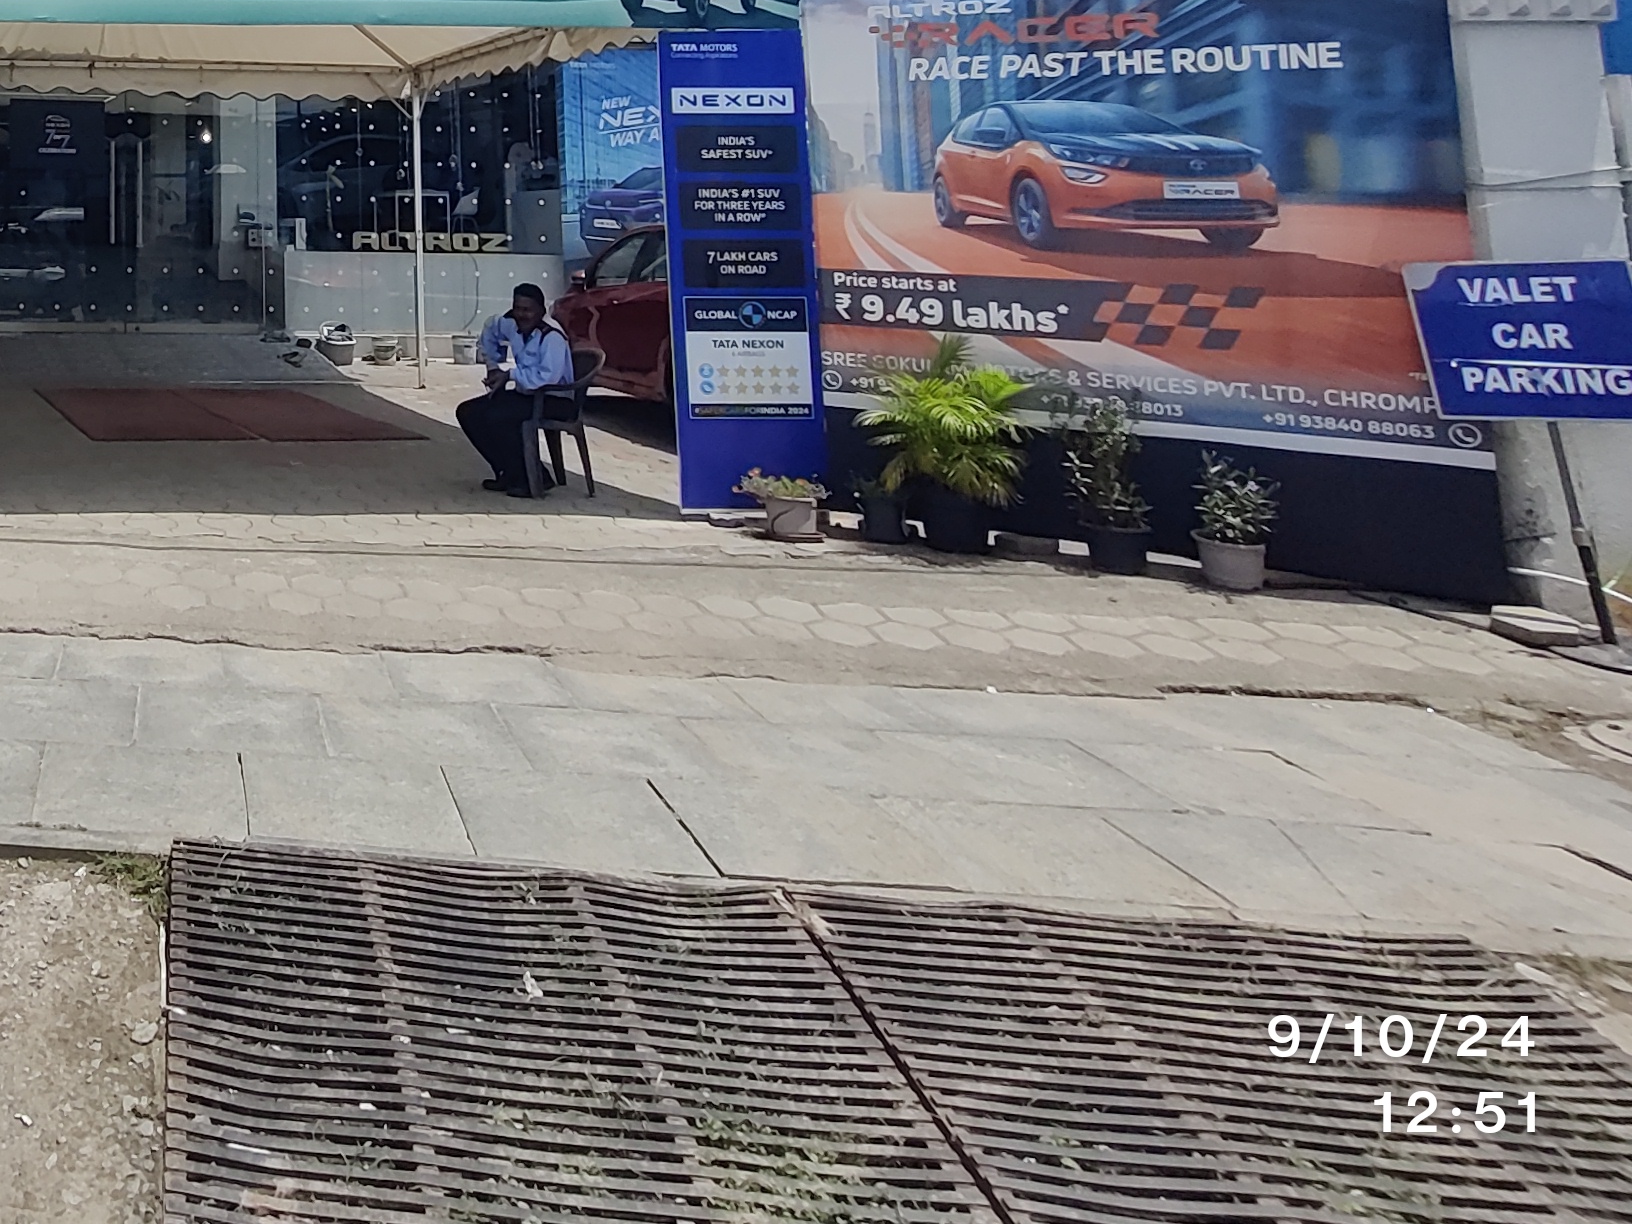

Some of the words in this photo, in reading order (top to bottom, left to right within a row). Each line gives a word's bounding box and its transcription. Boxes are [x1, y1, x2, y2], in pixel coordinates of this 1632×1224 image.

[920, 12, 1160, 47] RACER
[670, 43, 698, 52] TATA
[699, 43, 738, 53] MOTORS
[909, 55, 990, 82] RACE
[1000, 51, 1090, 79] PAST
[1095, 48, 1166, 76] THE
[1172, 41, 1344, 74] ROUTINE
[602, 95, 631, 110] NEW
[679, 94, 787, 107] NEXON
[609, 129, 645, 148] WAY
[717, 136, 755, 146] INDIA'S
[700, 149, 744, 159] SAFEST
[698, 188, 739, 199] INDIA'S
[741, 188, 755, 198] #1
[757, 188, 780, 198] SUV
[694, 201, 715, 211] FOR
[717, 201, 751, 210] THREE
[751, 201, 786, 211] YEARS
[714, 213, 726, 223] IN
[727, 213, 735, 222] A
[352, 230, 511, 252] ALTROZ
[707, 251, 715, 264] 7
[716, 252, 747, 262] LAKH
[748, 251, 778, 262] CARS
[720, 265, 736, 274] ON
[738, 265, 767, 274] ROAD
[833, 272, 877, 288] Price
[881, 276, 935, 292] starts
[937, 278, 957, 292] at
[1457, 276, 1577, 303] VALET
[694, 310, 738, 319] GLOBAL
[767, 310, 797, 319] NCAP
[835, 292, 851, 320] ₹
[861, 294, 944, 326] 9.49
[1491, 323, 1573, 349] CAR
[711, 339, 739, 349] TATA
[742, 339, 785, 349] NEXON
[821, 350, 867, 368] SREE
[1068, 370, 1082, 387] &
[1086, 372, 1198, 395] SERVICES
[1204, 380, 1256, 400] PVT.
[1461, 367, 1632, 396] PARKING
[1263, 412, 1295, 426] +91
[1299, 414, 1362, 433] 93840
[1367, 419, 1435, 439] 88063
